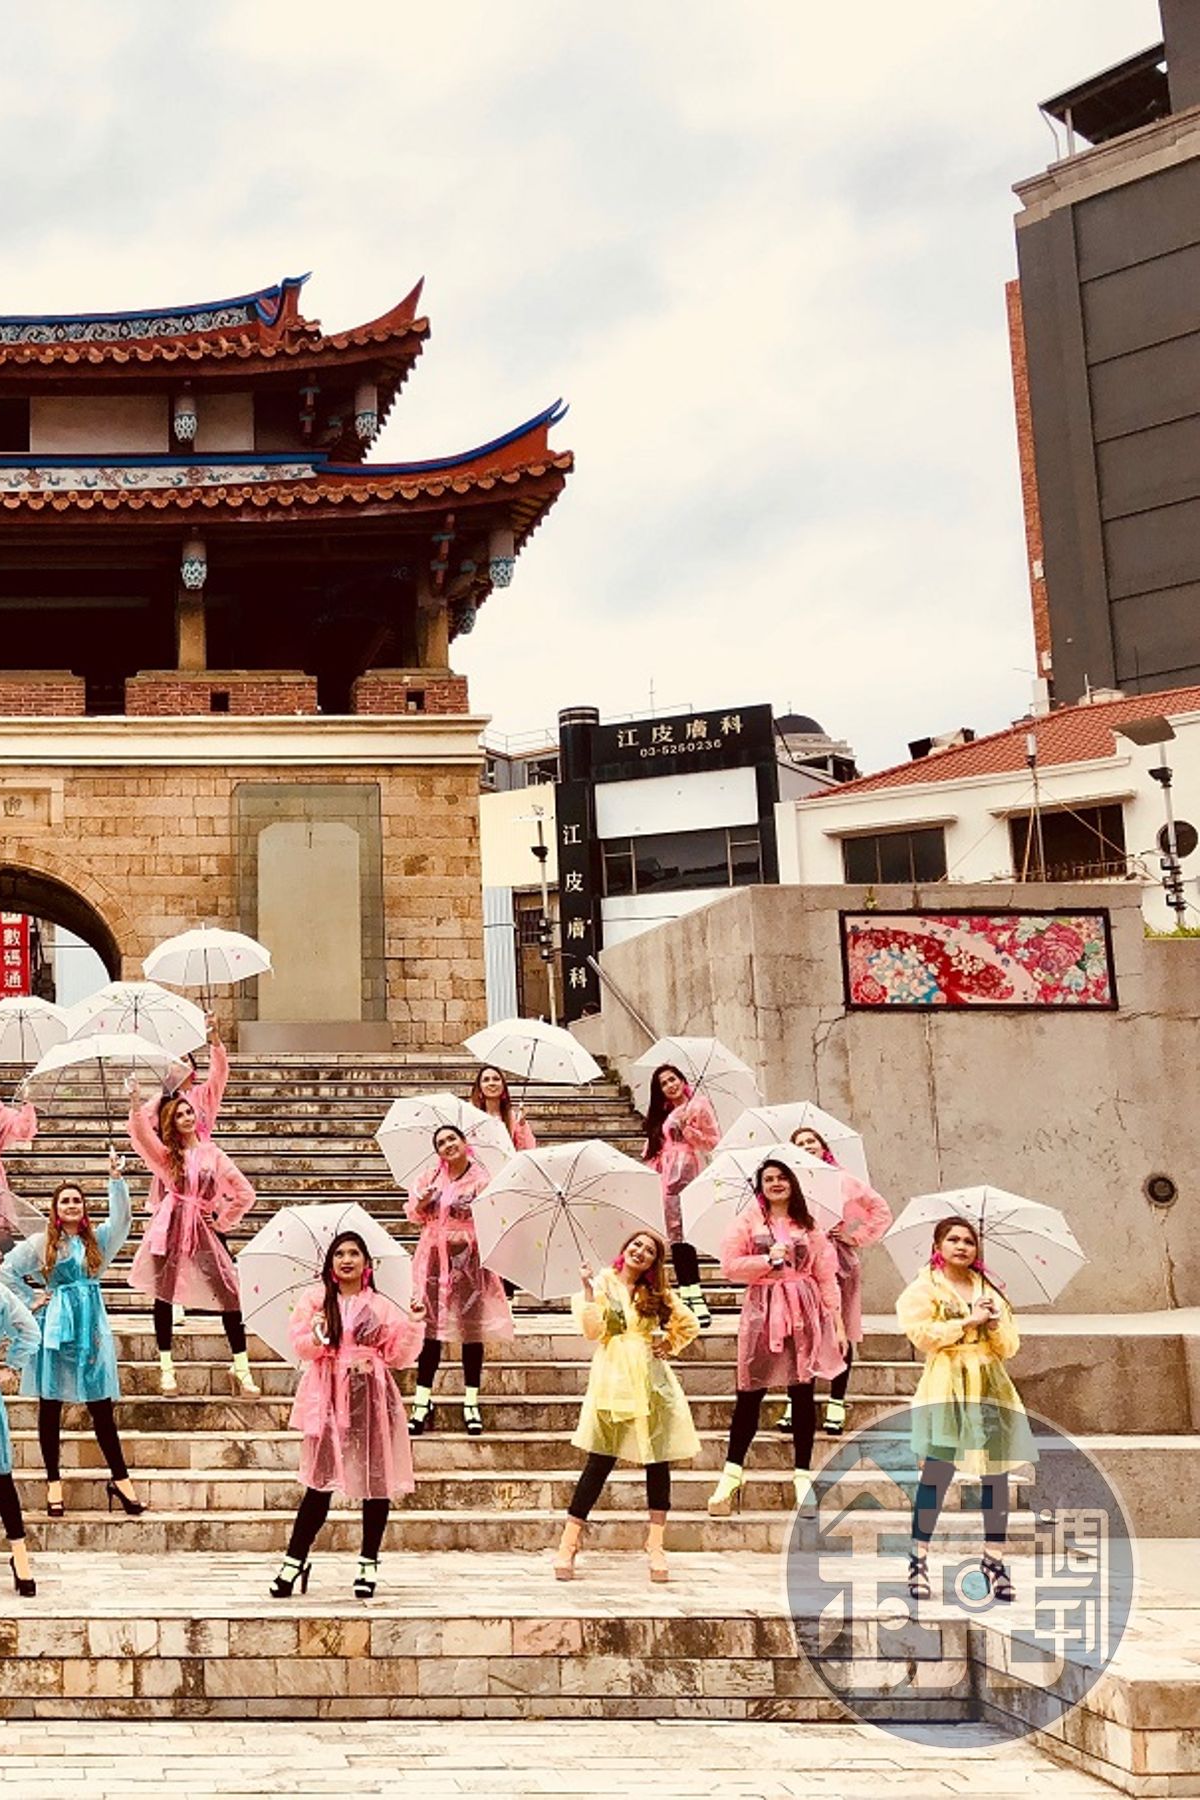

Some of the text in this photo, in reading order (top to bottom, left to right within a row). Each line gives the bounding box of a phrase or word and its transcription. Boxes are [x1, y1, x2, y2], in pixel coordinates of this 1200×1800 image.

[617, 714, 743, 748] 江皮膚科
[563, 824, 587, 989] 江皮膚科
